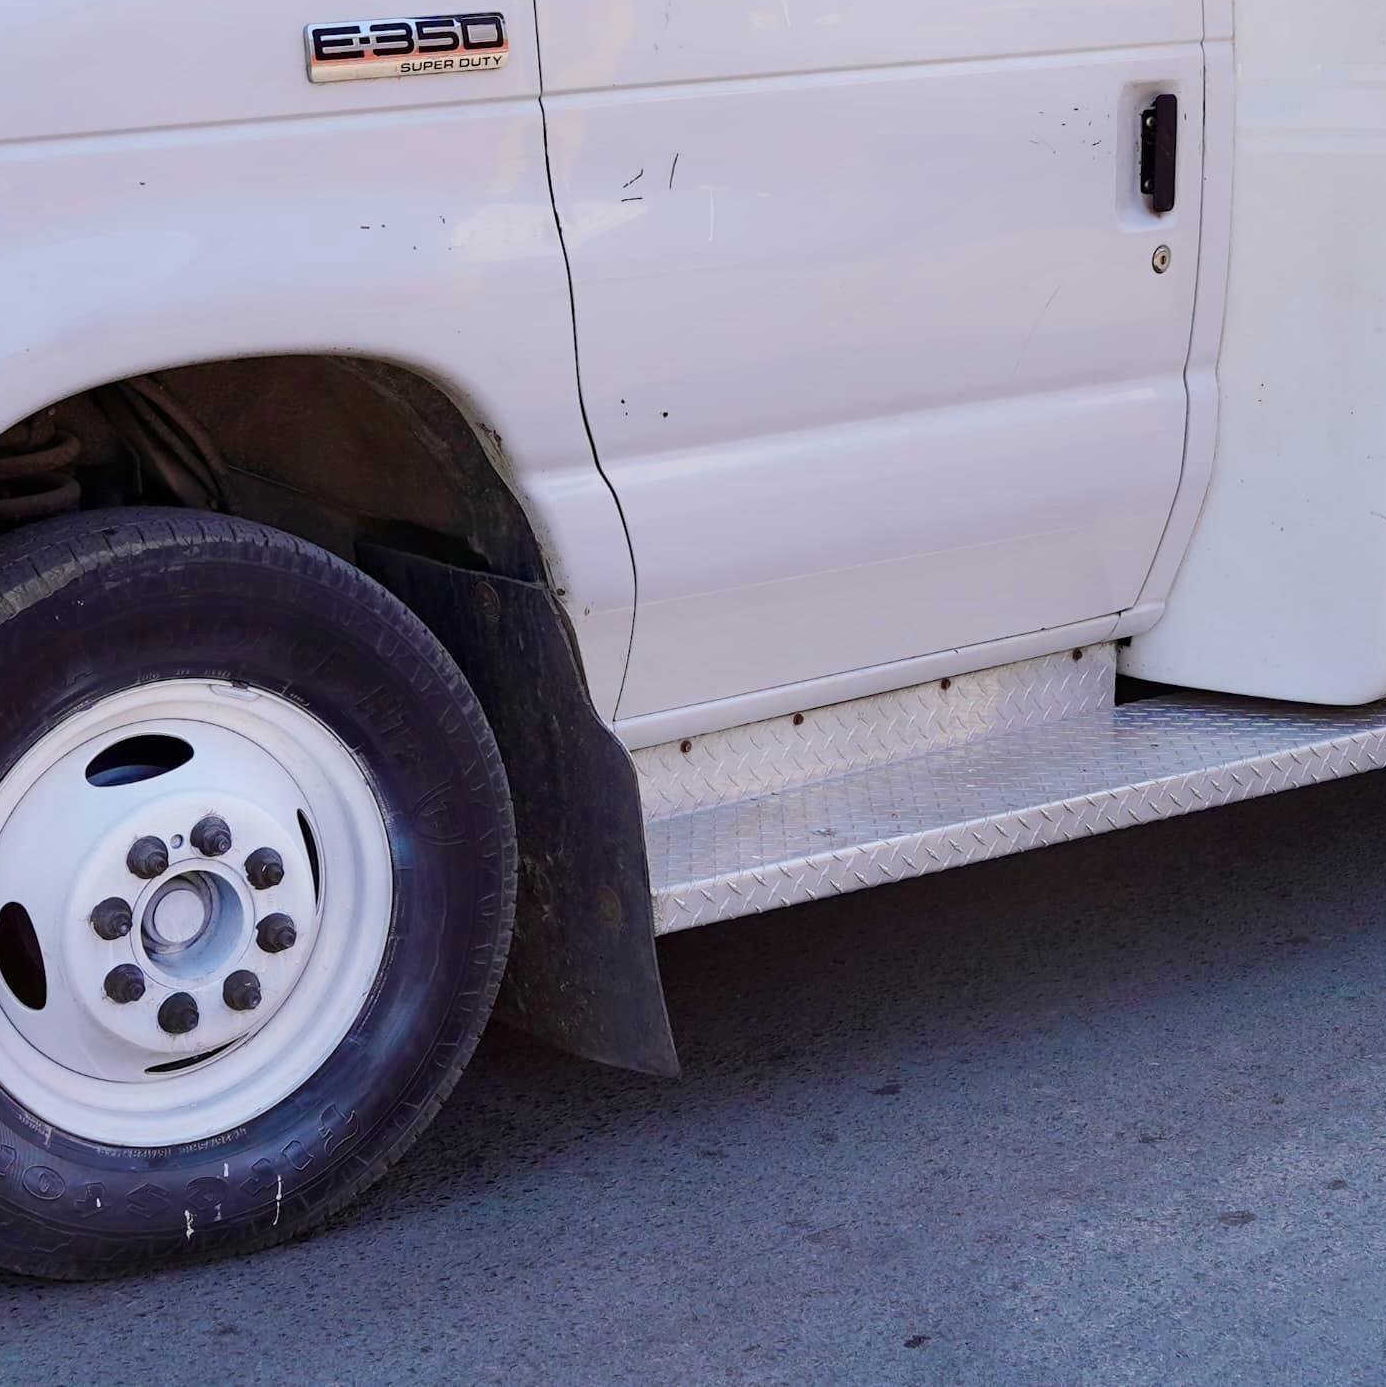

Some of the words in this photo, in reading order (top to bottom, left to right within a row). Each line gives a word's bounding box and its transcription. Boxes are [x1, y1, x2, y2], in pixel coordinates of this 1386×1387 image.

[312, 16, 504, 61] E-350
[400, 59, 454, 73] SUPER
[459, 55, 502, 68] DUTY
